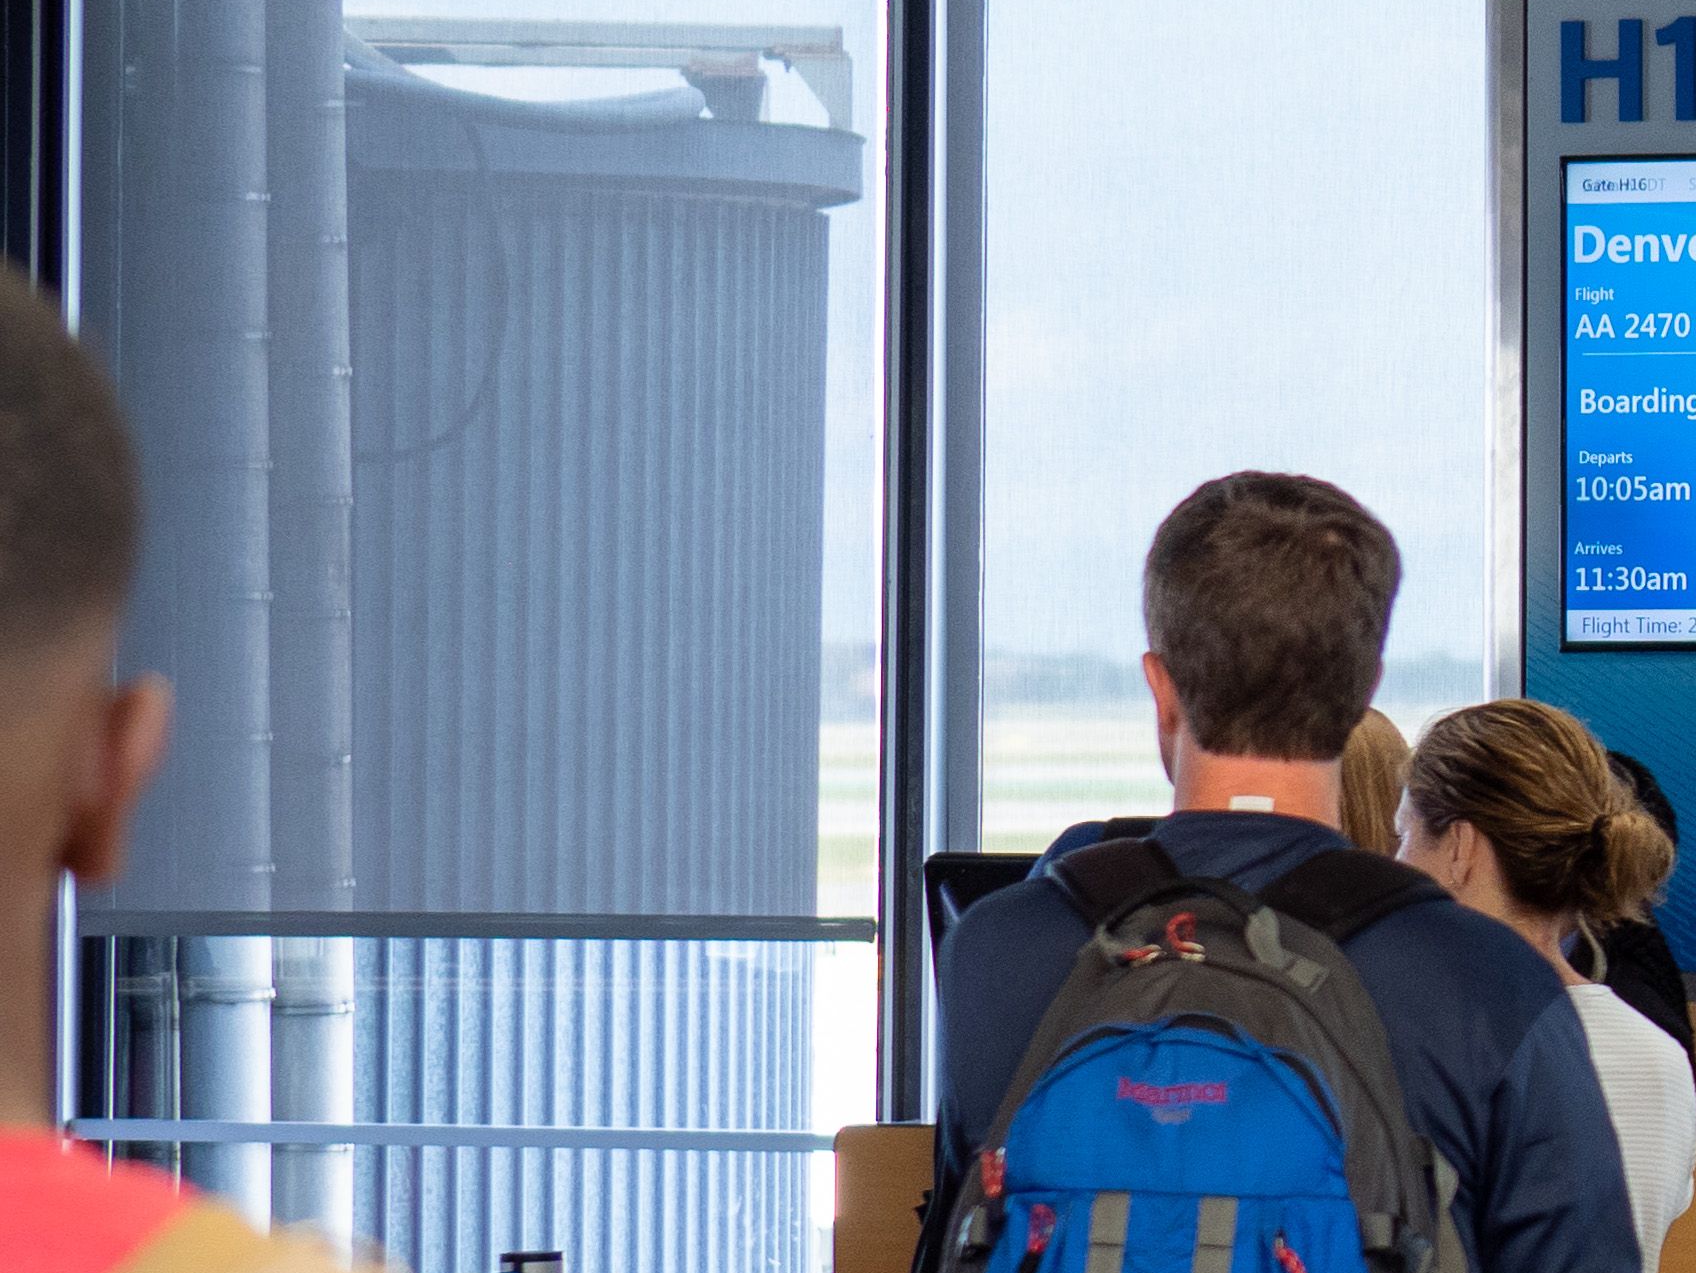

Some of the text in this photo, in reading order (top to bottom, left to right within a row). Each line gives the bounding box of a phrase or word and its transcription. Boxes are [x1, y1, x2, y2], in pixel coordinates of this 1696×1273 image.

[1582, 178, 1647, 192] Gate H16
[1575, 287, 1615, 304] Flight
[1575, 312, 1691, 340] AA 2470
[1579, 450, 1634, 468] Departs
[1575, 475, 1691, 502] 10:05am
[1574, 541, 1624, 556] Arrives
[1575, 566, 1688, 593] 11:30am
[1582, 616, 1631, 638] Flight
[1636, 615, 1682, 635] Time:
